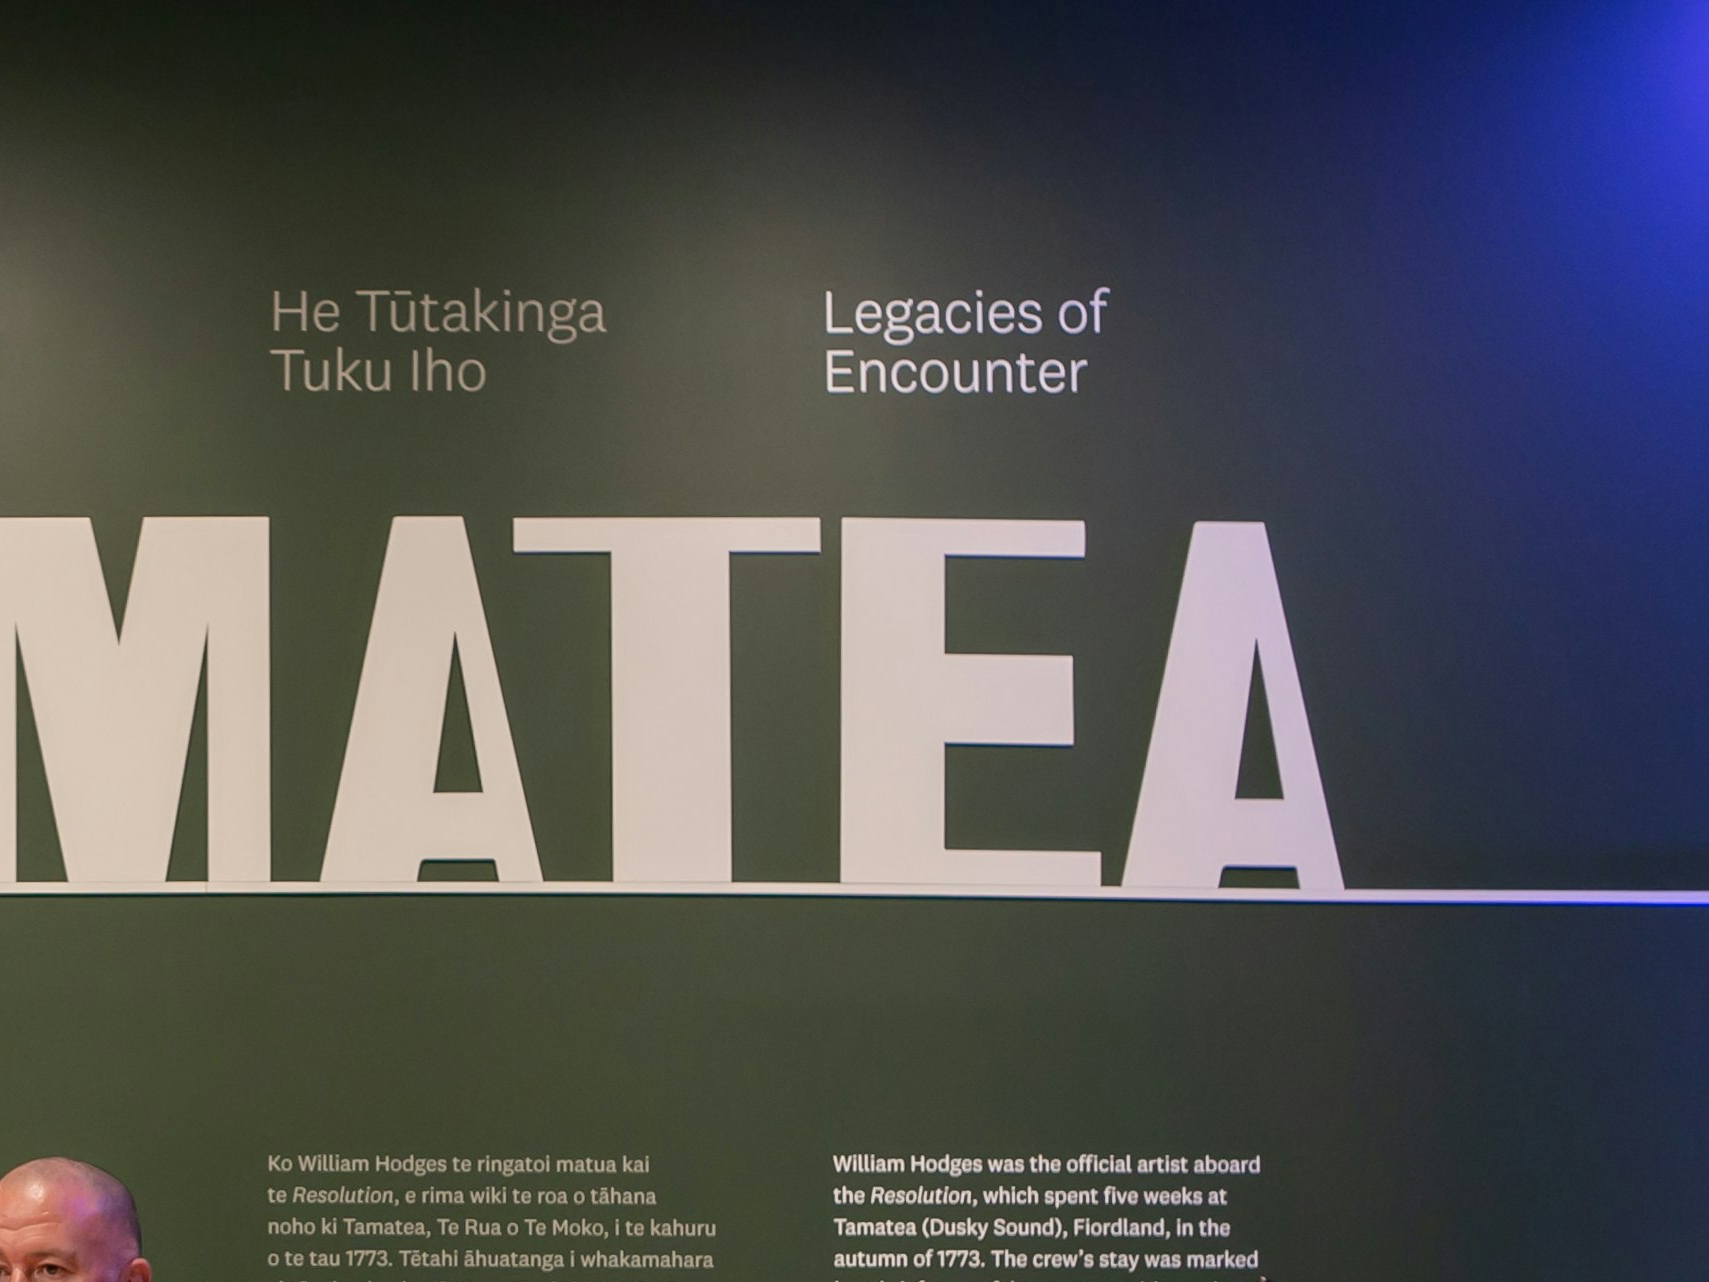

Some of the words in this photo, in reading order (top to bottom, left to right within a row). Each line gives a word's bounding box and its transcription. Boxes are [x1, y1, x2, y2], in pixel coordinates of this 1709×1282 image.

[272, 290, 341, 333] He
[354, 287, 608, 345] Tūtakinga
[825, 289, 1044, 346] Legacies
[1058, 287, 1111, 335] of
[269, 346, 392, 393] Tuku
[411, 346, 487, 393] Iho
[825, 350, 1089, 394] Encounter
[267, 1154, 294, 1173] Ko
[297, 1153, 370, 1173] William
[375, 1153, 448, 1177] Hodges
[451, 1156, 472, 1173] te
[477, 1154, 551, 1178] ringatoi
[555, 1156, 618, 1174] matua
[622, 1154, 650, 1174] kai
[832, 1153, 906, 1174] William
[910, 1153, 984, 1178] Hodges
[986, 1157, 1026, 1174] was
[1028, 1153, 1062, 1174] the
[1065, 1153, 1133, 1175] official
[1136, 1154, 1190, 1175] artist
[1192, 1153, 1262, 1176] aboard
[266, 1187, 288, 1204] te
[291, 1185, 400, 1207] Resolution,
[404, 1190, 417, 1205] e
[421, 1185, 466, 1205] rima
[469, 1185, 507, 1205] wiki
[511, 1188, 532, 1205] te
[537, 1190, 569, 1205] roa
[573, 1190, 586, 1206] o
[589, 1185, 658, 1206] tāhana
[832, 1184, 866, 1206] the
[870, 1184, 979, 1208] Resolution,
[982, 1184, 1040, 1206] which
[1043, 1187, 1100, 1210] spent
[1102, 1184, 1140, 1206] five
[1142, 1185, 1204, 1207] weeks
[1207, 1187, 1229, 1207] at
[832, 1217, 918, 1237] Tamatea
[921, 1216, 990, 1242] (Dusky
[992, 1216, 1069, 1241] Sound),
[1073, 1216, 1172, 1241] Fiordland,
[1175, 1217, 1195, 1238] in
[1197, 1217, 1232, 1238] the
[267, 1252, 280, 1267] o
[283, 1250, 305, 1268] te
[308, 1250, 341, 1268] tau
[345, 1249, 394, 1268] 1773.
[398, 1248, 459, 1268] Tētahi
[463, 1248, 565, 1273] āhuatanga
[569, 1249, 575, 1268] i
[579, 1249, 715, 1269] whakamahara
[833, 1250, 909, 1269] autumn
[912, 1247, 935, 1269] of
[936, 1249, 986, 1269] 1773.
[989, 1248, 1029, 1269] The
[1031, 1247, 1095, 1269] crew’s
[1098, 1250, 1141, 1274] stay
[1143, 1253, 1182, 1270] was
[1186, 1248, 1260, 1270] marked
